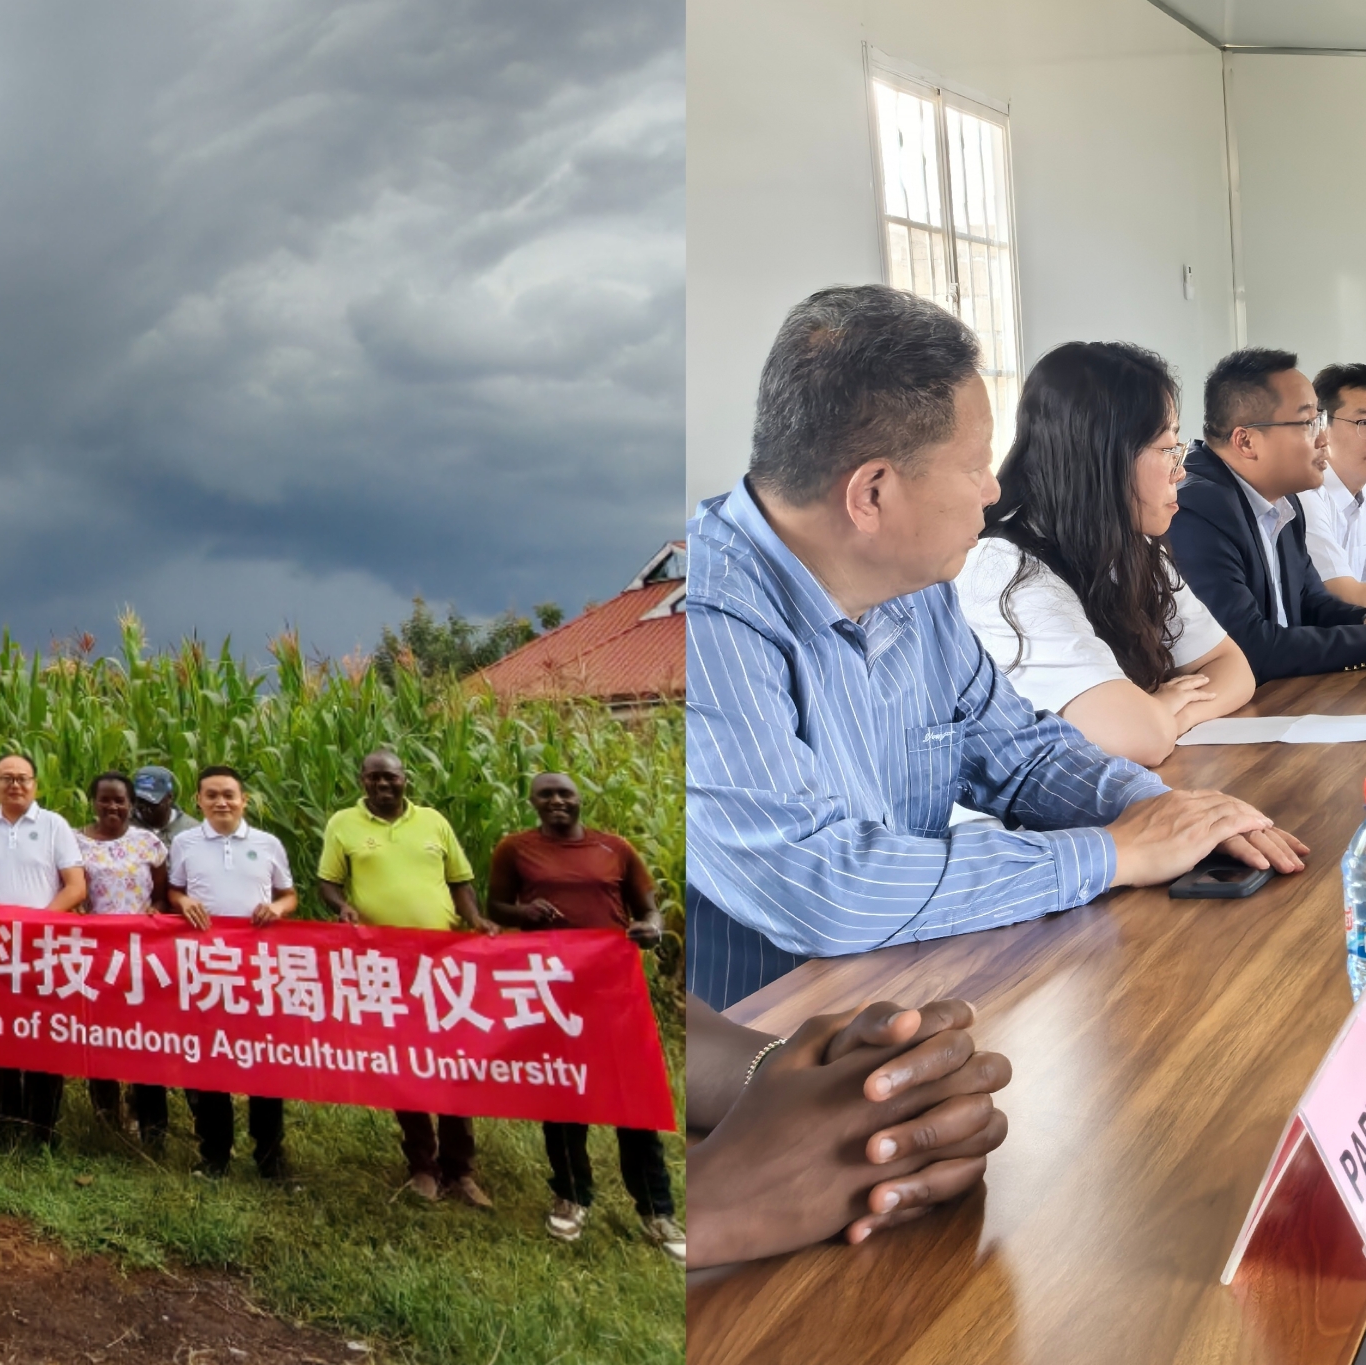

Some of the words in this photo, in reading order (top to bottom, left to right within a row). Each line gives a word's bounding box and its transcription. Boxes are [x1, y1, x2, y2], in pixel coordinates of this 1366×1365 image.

[13, 1012, 42, 1038] of
[49, 1013, 201, 1063] Shandong
[211, 1029, 399, 1075] Agricultural
[408, 1046, 587, 1096] University
